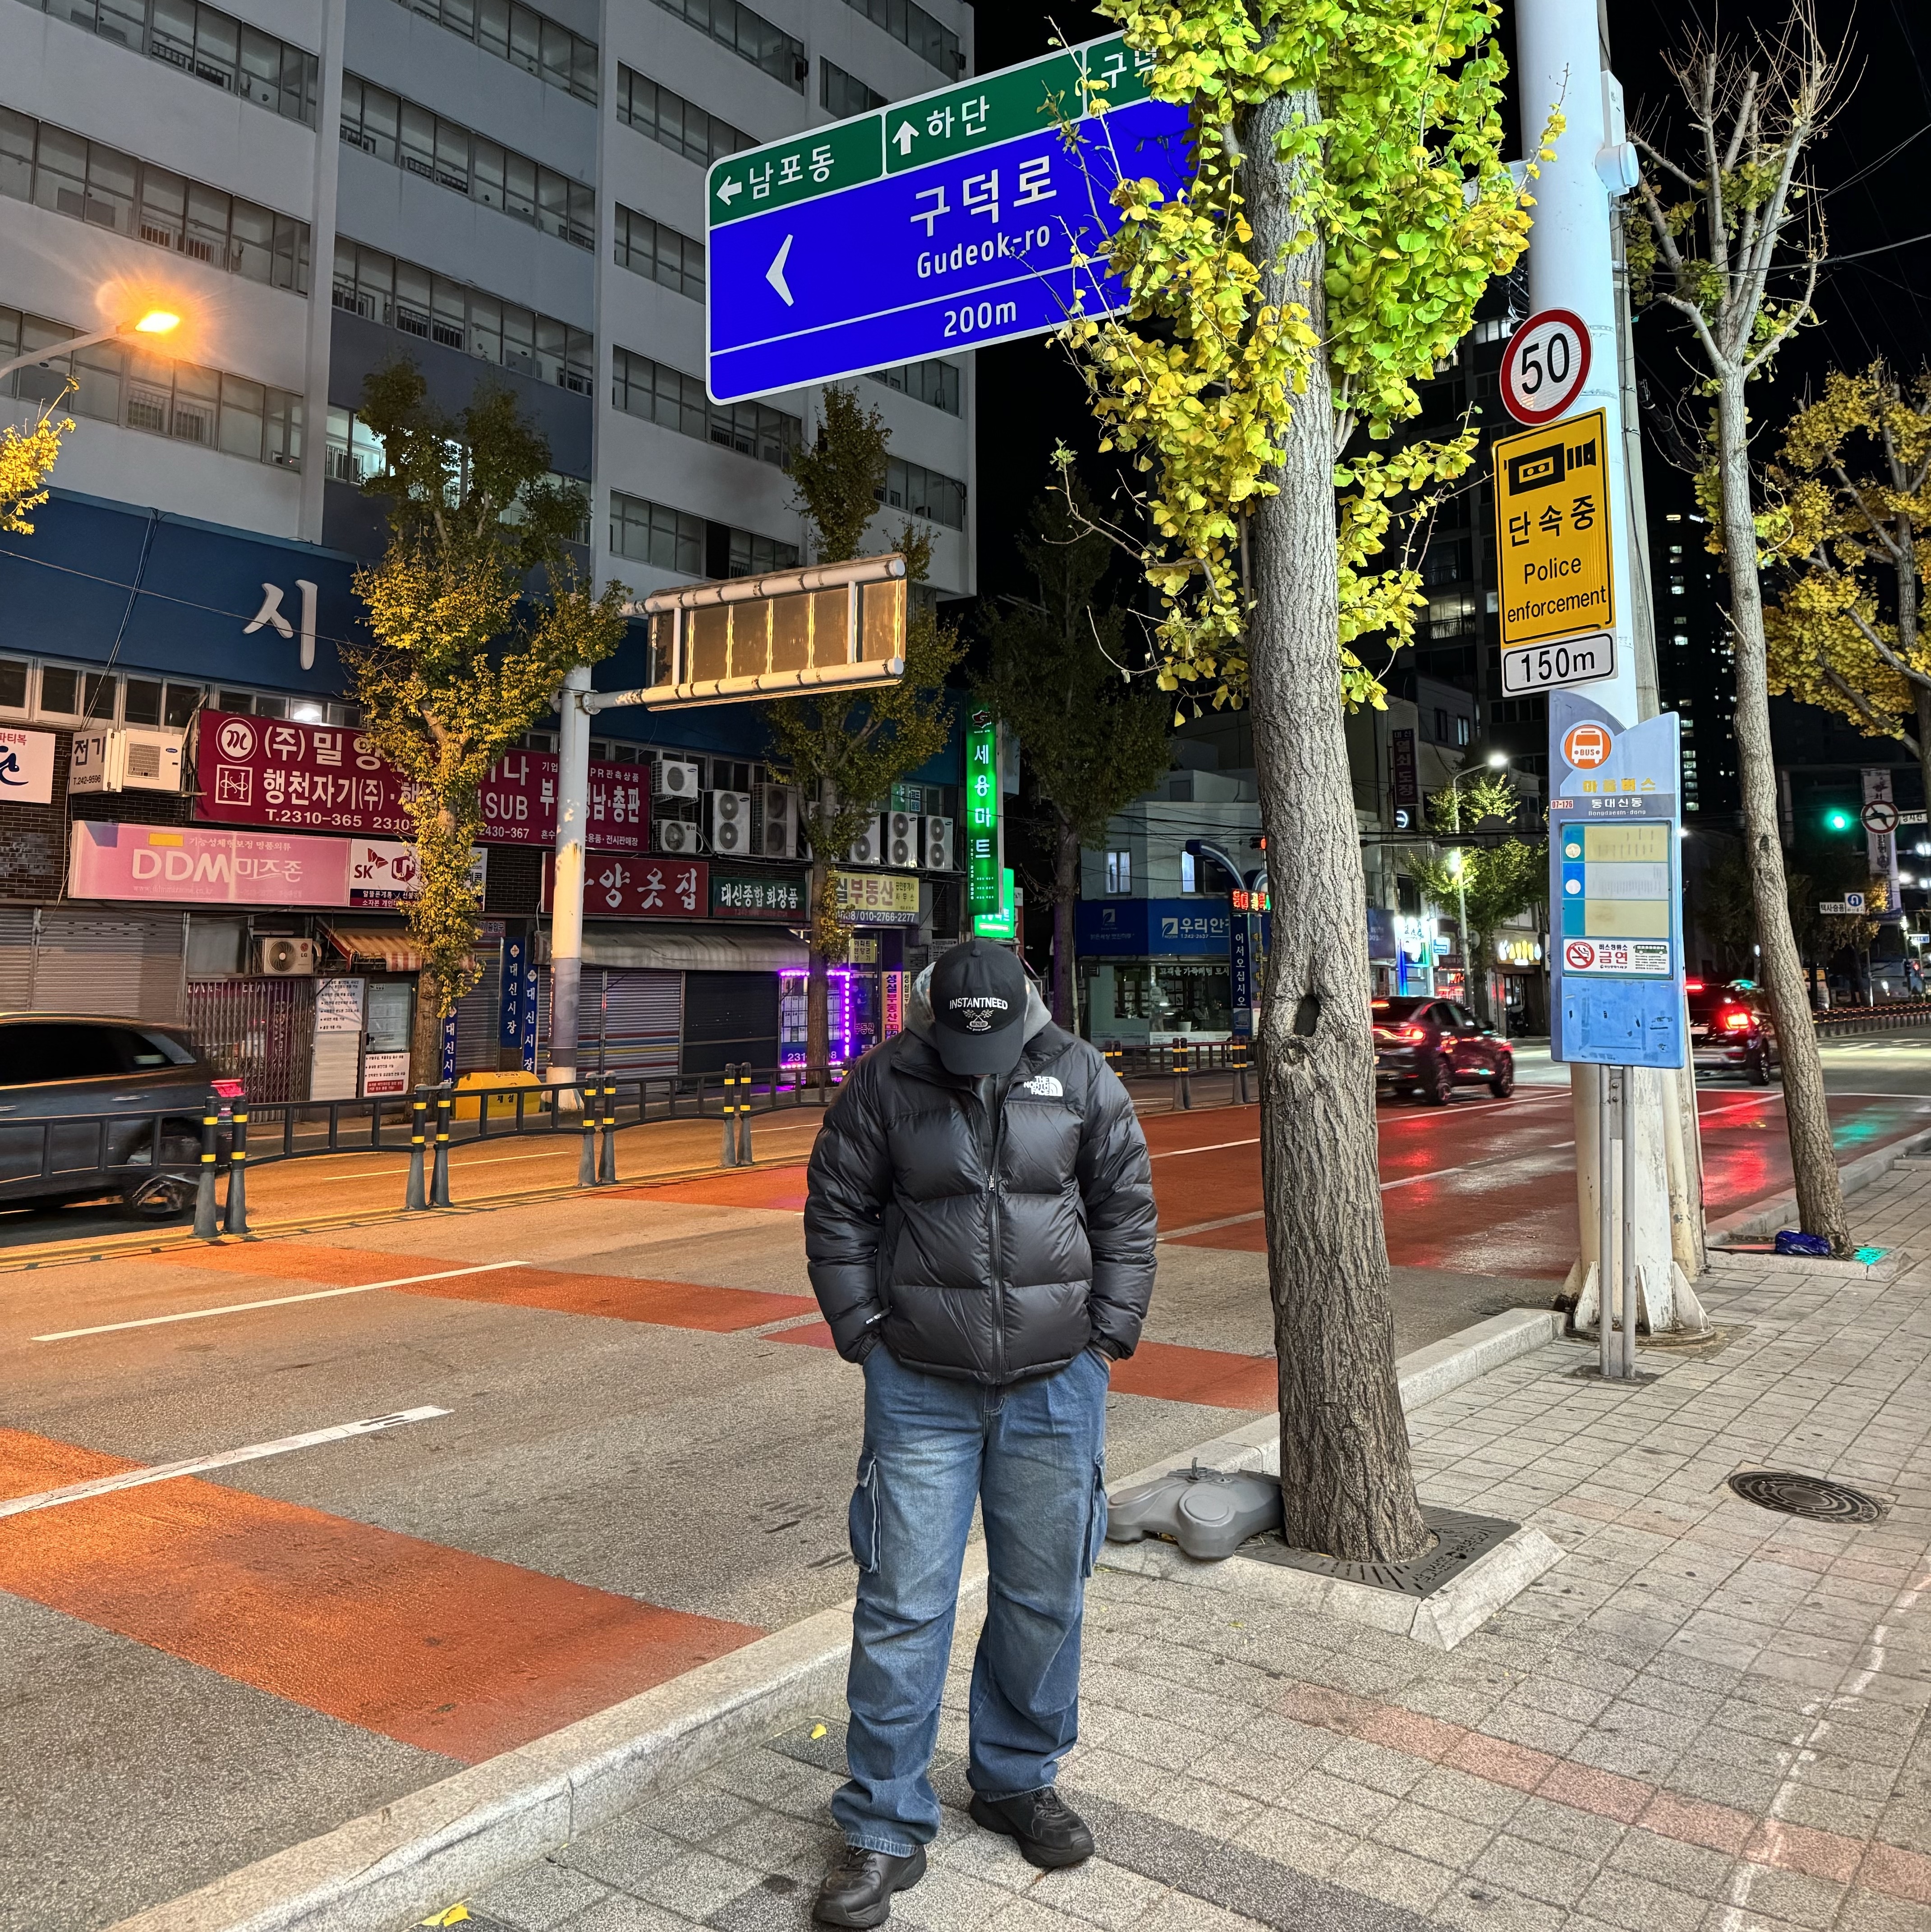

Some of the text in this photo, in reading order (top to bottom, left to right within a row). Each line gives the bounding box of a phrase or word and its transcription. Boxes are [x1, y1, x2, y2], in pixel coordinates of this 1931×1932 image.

[926, 96, 991, 139] 하단
[748, 144, 835, 200] 남포동
[910, 154, 1057, 237] 구덕로
[916, 224, 1051, 279] Gudeok-ro
[943, 298, 1017, 338] 200m
[1521, 333, 1570, 395] 50
[1509, 494, 1596, 548] 단속중
[1524, 557, 1582, 585] Police
[242, 579, 318, 670] 시
[1507, 585, 1608, 624] enforcement
[1520, 647, 1596, 684] 150m
[73, 775, 101, 786] T.242-9596
[265, 809, 362, 827] T.2310-365
[974, 744, 991, 858] 세용마트
[1592, 797, 1643, 809] 동대신동
[132, 849, 231, 883] DDM
[354, 864, 374, 879] SK
[585, 862, 697, 911] 양옷집
[721, 883, 799, 909] 대신종합 화장품
[1235, 933, 1247, 1007] 어서오십시오
[1598, 951, 1628, 965] 금연
[507, 963, 517, 1035] 대신시장
[886, 974, 897, 1022] 성실부동산
[949, 997, 1008, 1010] INSTANTNEED
[523, 988, 535, 1071] 대신시장
[1023, 1081, 1049, 1089] NORTH
[1030, 1088, 1049, 1096] FACE
